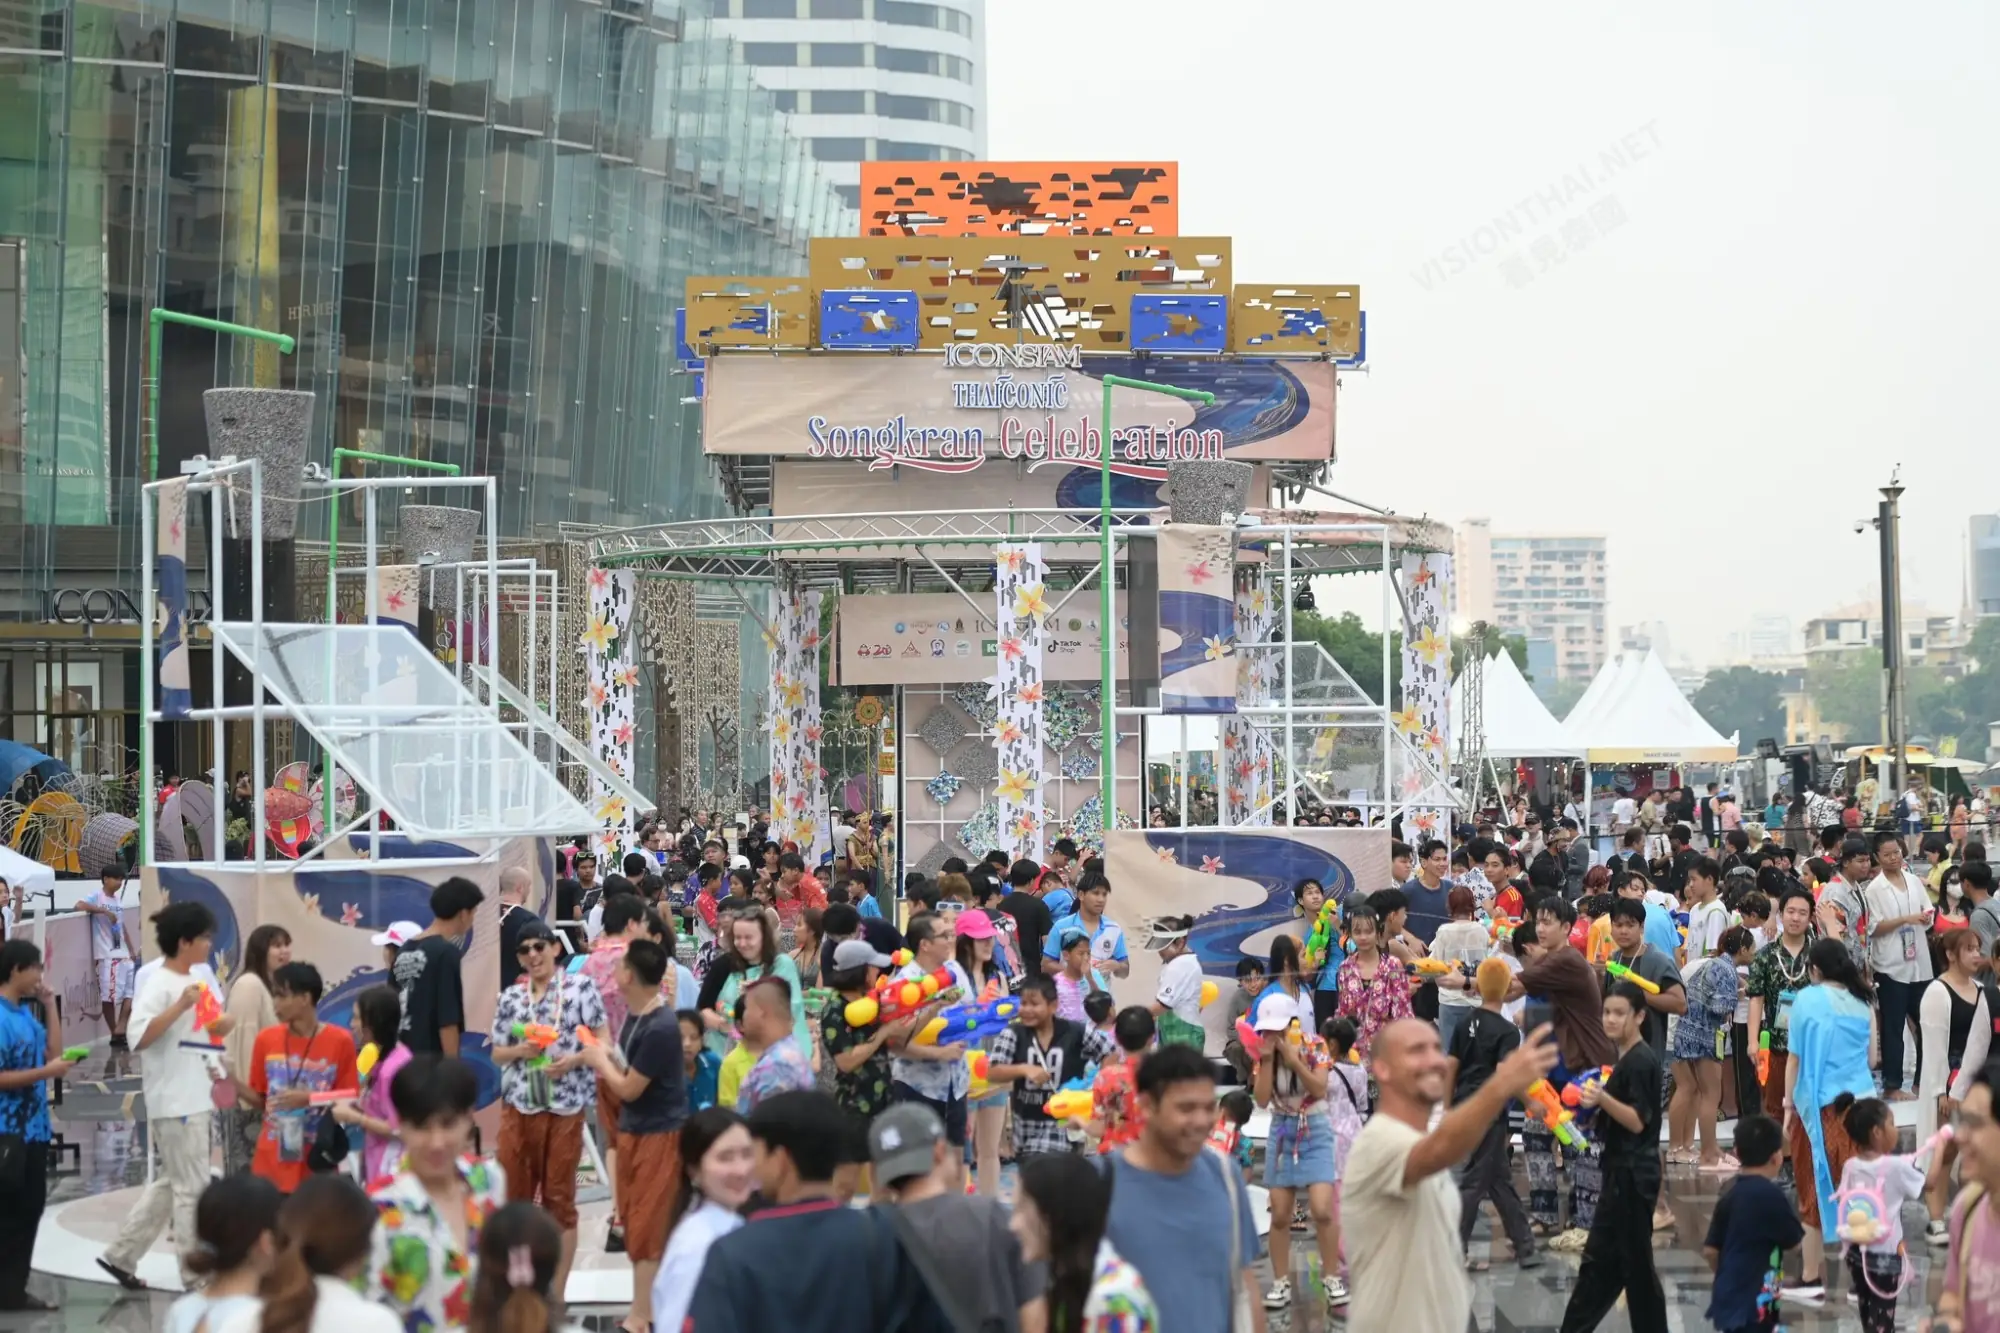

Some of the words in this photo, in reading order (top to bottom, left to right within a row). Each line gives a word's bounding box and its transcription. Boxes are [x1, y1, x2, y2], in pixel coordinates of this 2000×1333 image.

[943, 342, 1082, 368] ICONSIAM
[807, 413, 986, 472] Songkran
[1000, 414, 1225, 474] Celebration
